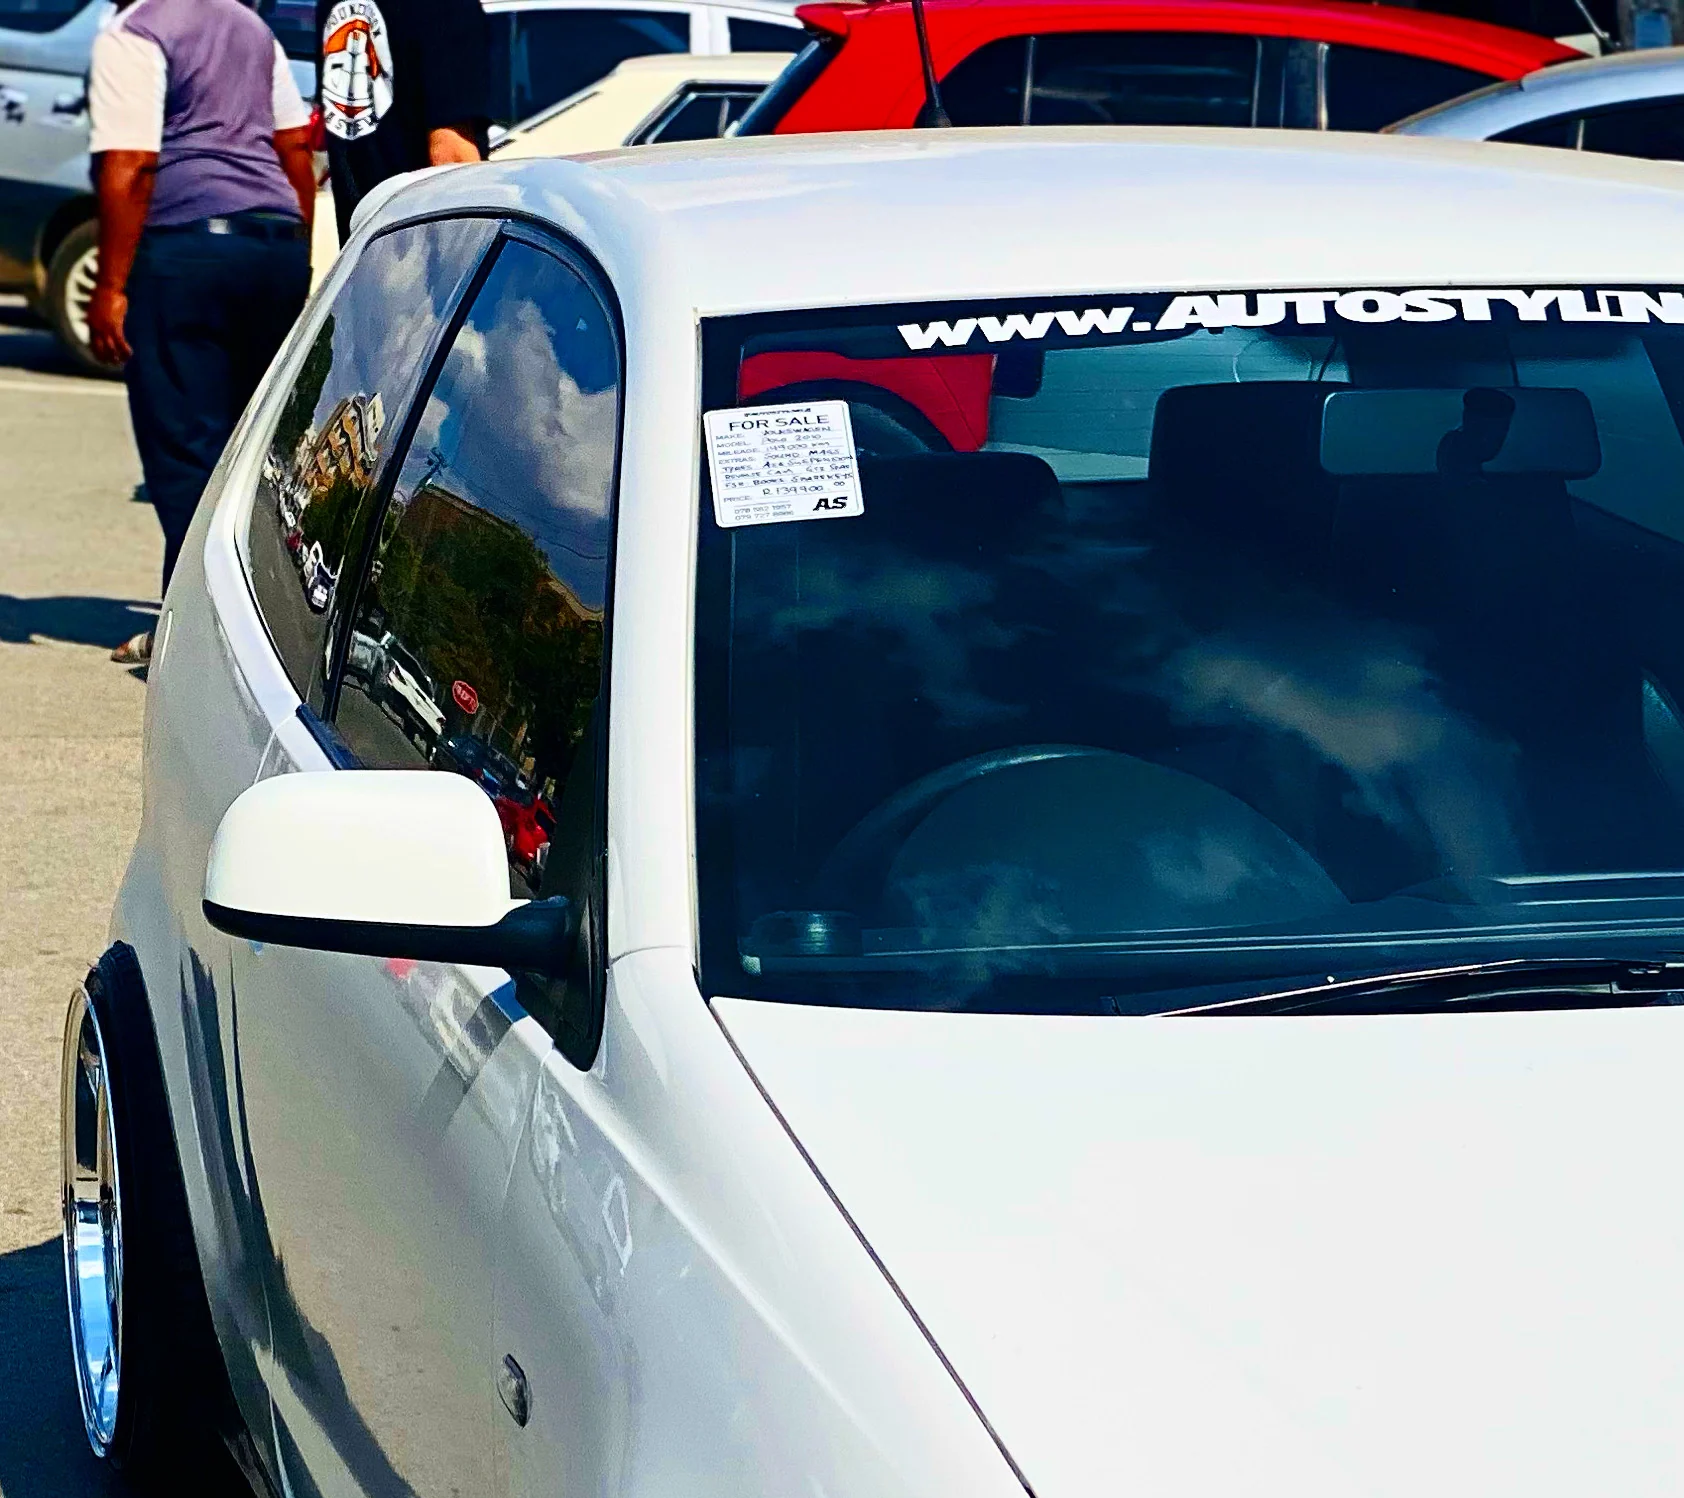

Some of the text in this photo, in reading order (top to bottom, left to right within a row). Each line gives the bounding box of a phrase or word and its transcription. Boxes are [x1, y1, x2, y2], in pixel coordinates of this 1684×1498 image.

[729, 415, 829, 431] FOR SALE
[813, 496, 848, 511] AS
